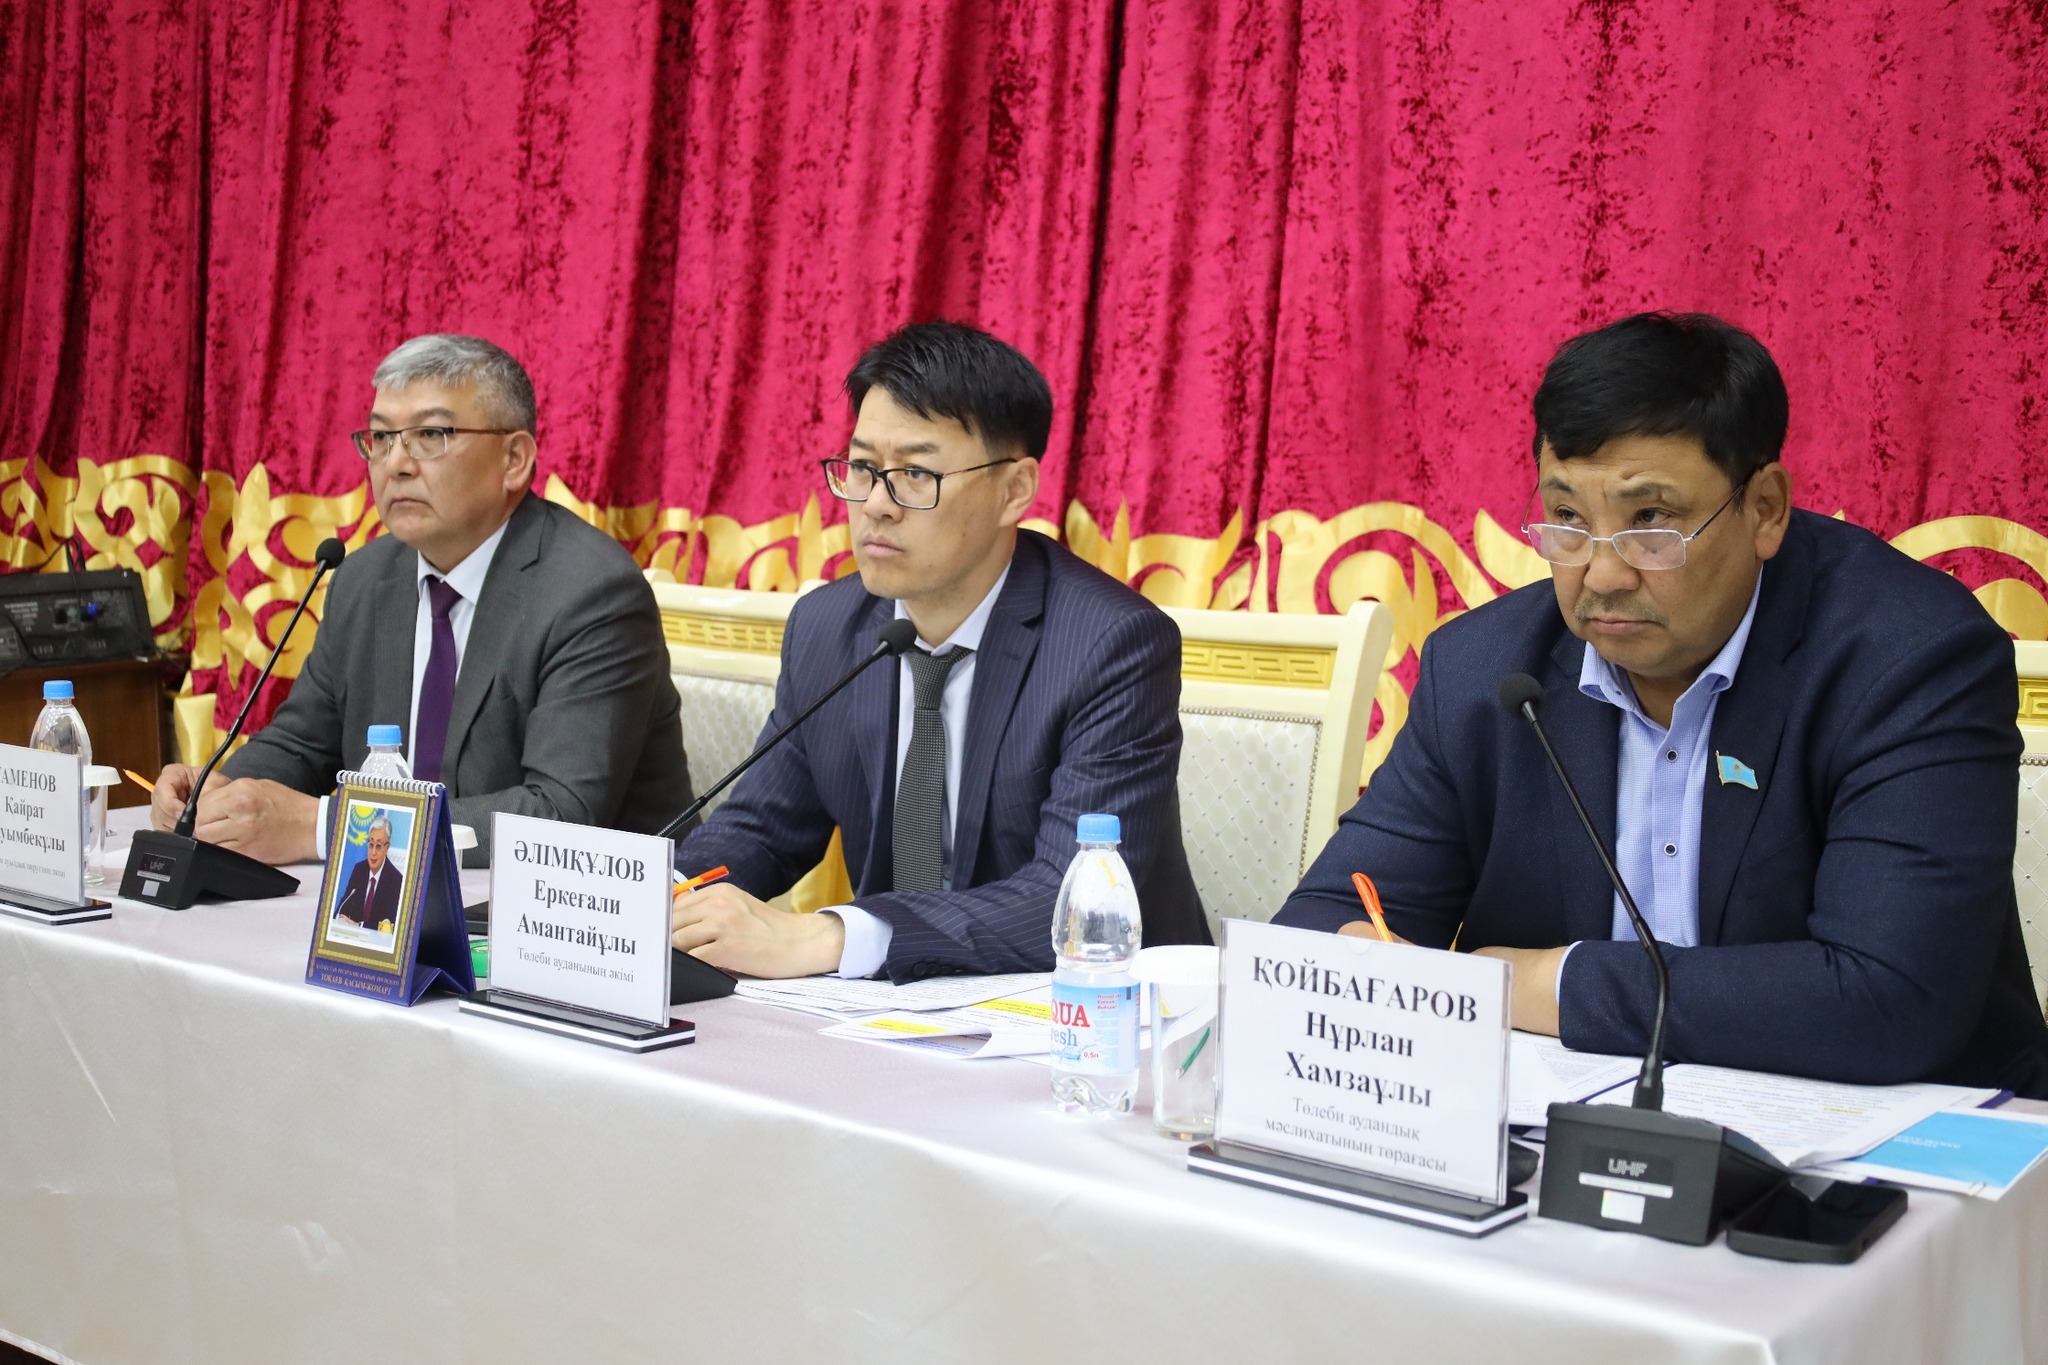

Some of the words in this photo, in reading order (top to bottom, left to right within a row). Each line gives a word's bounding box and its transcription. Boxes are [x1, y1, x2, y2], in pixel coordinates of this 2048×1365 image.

[0, 766, 56, 792] АМЕНОВ
[0, 827, 65, 853] уымбекұлы
[514, 840, 645, 882] ӘЛІМҚҰЛОВ
[534, 879, 620, 915] Еркеғали
[517, 912, 636, 956] Амантайұлы
[518, 947, 551, 966] Төлеби
[553, 957, 607, 978] ауданының
[609, 967, 634, 983] әкімі
[1253, 956, 1477, 1023] ҚОЙБАҒАРОВ
[1306, 1011, 1413, 1057] Нұрлан
[1285, 1051, 1432, 1108] Хамзаұлы
[1293, 1096, 1344, 1123] Төлеби
[1265, 1118, 1373, 1155] мәслихатының
[1378, 1145, 1448, 1173] төрағасы
[1607, 1157, 1648, 1177] UHF
